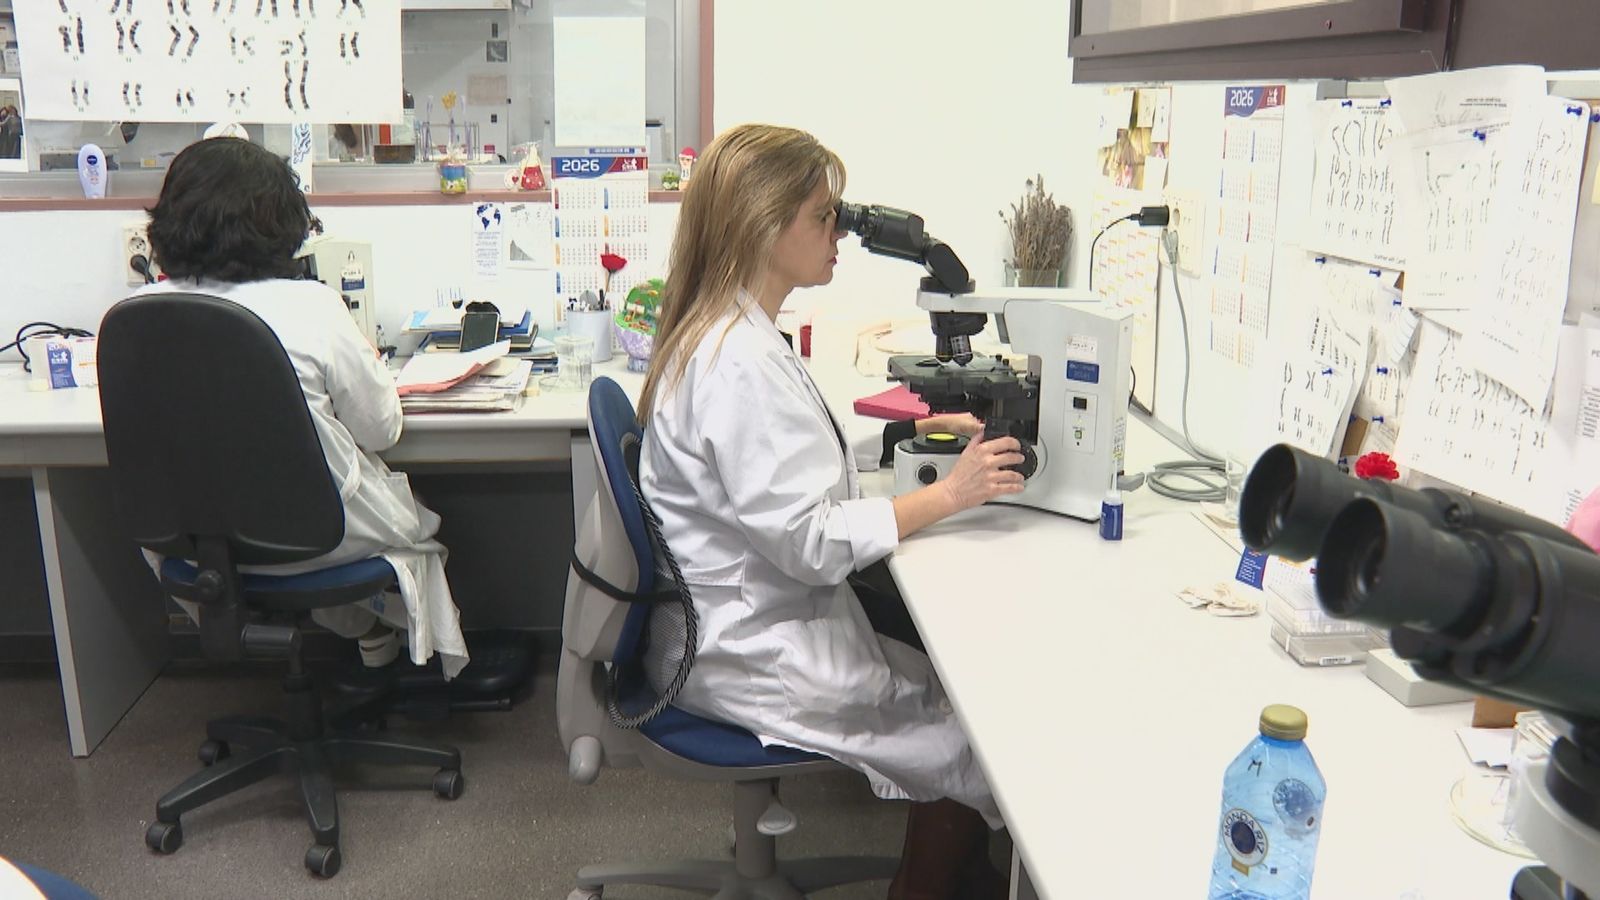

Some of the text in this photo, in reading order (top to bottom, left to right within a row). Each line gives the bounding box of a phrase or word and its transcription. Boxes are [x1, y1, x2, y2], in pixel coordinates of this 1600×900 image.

[1230, 89, 1254, 106] 2026
[561, 159, 600, 172] 2026
[1224, 811, 1265, 855] MONDARIZ
